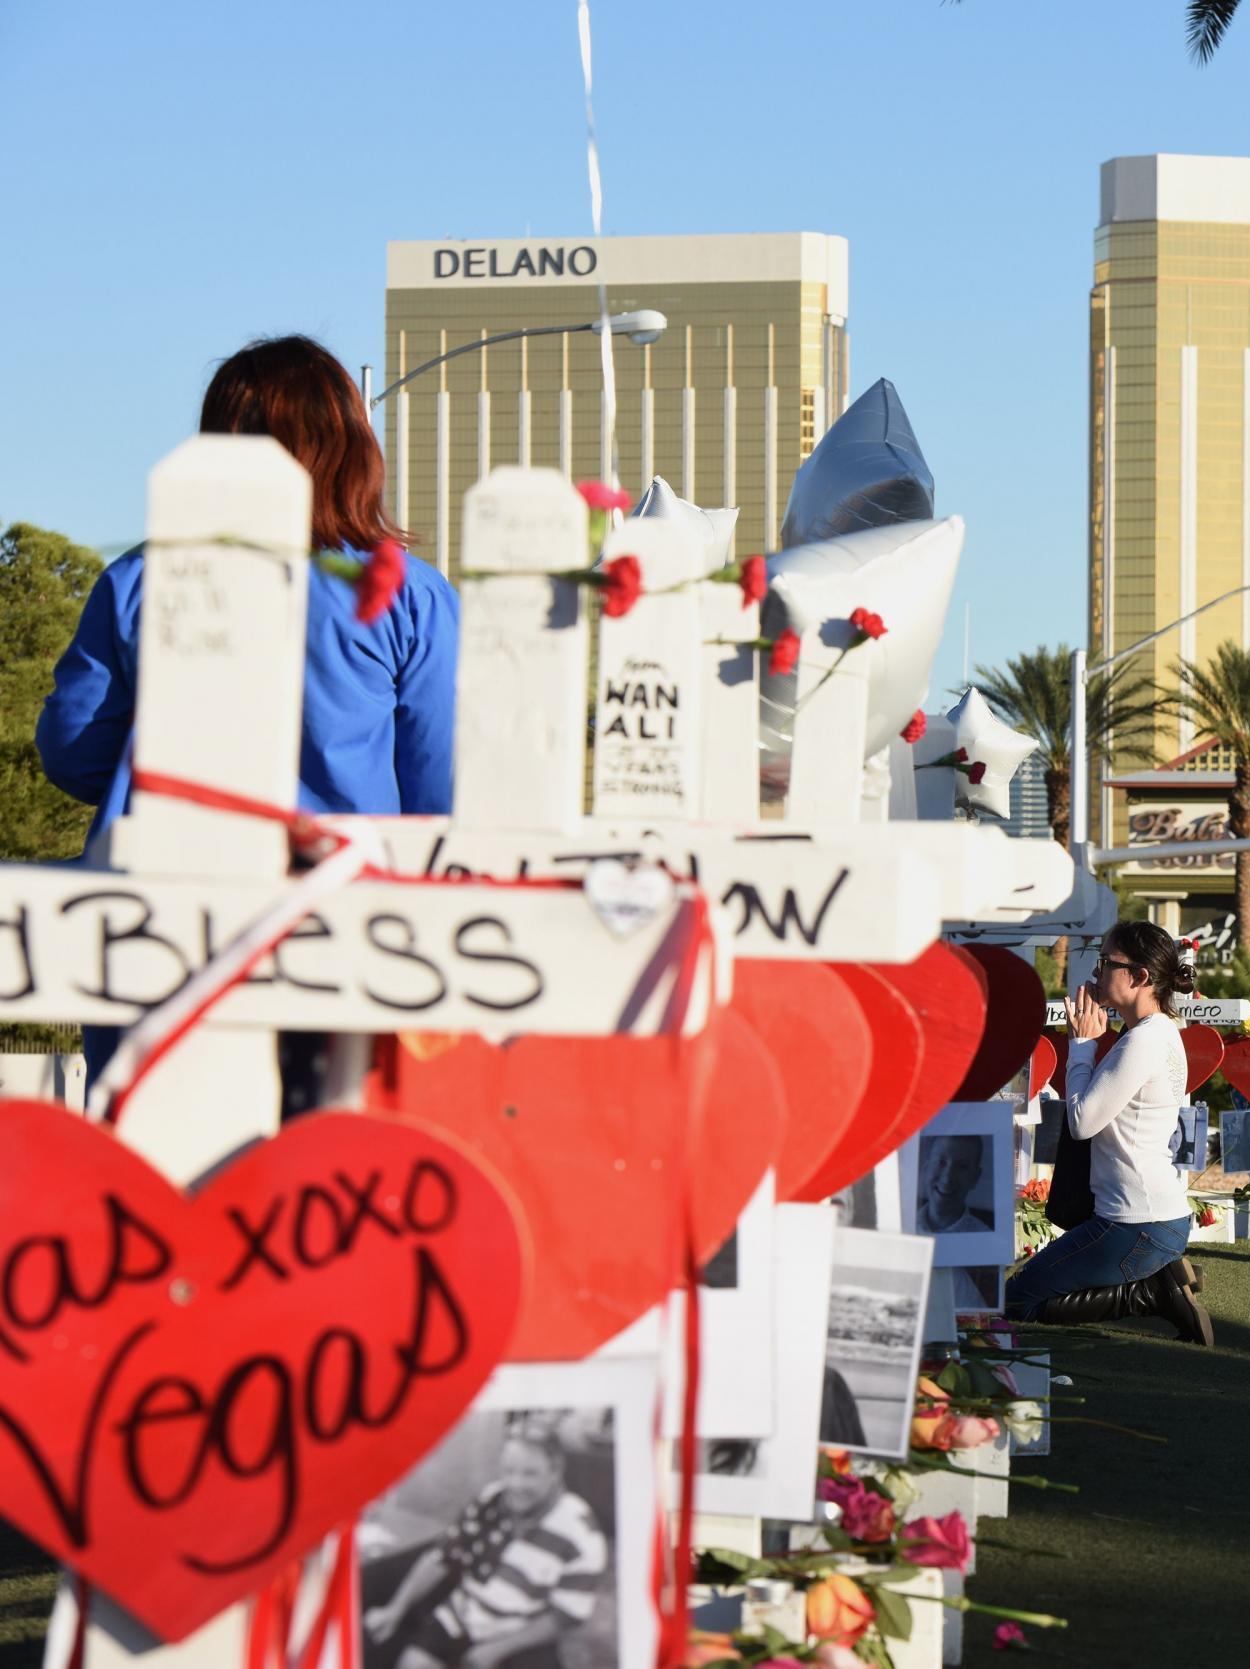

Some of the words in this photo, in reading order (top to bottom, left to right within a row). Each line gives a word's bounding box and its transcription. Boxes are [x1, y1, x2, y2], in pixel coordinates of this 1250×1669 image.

[433, 246, 598, 279] DELANO
[604, 714, 674, 739] ALI
[1134, 807, 1225, 842] Bali
[217, 1158, 458, 1293] xoxo
[0, 1242, 470, 1577] Vegas
